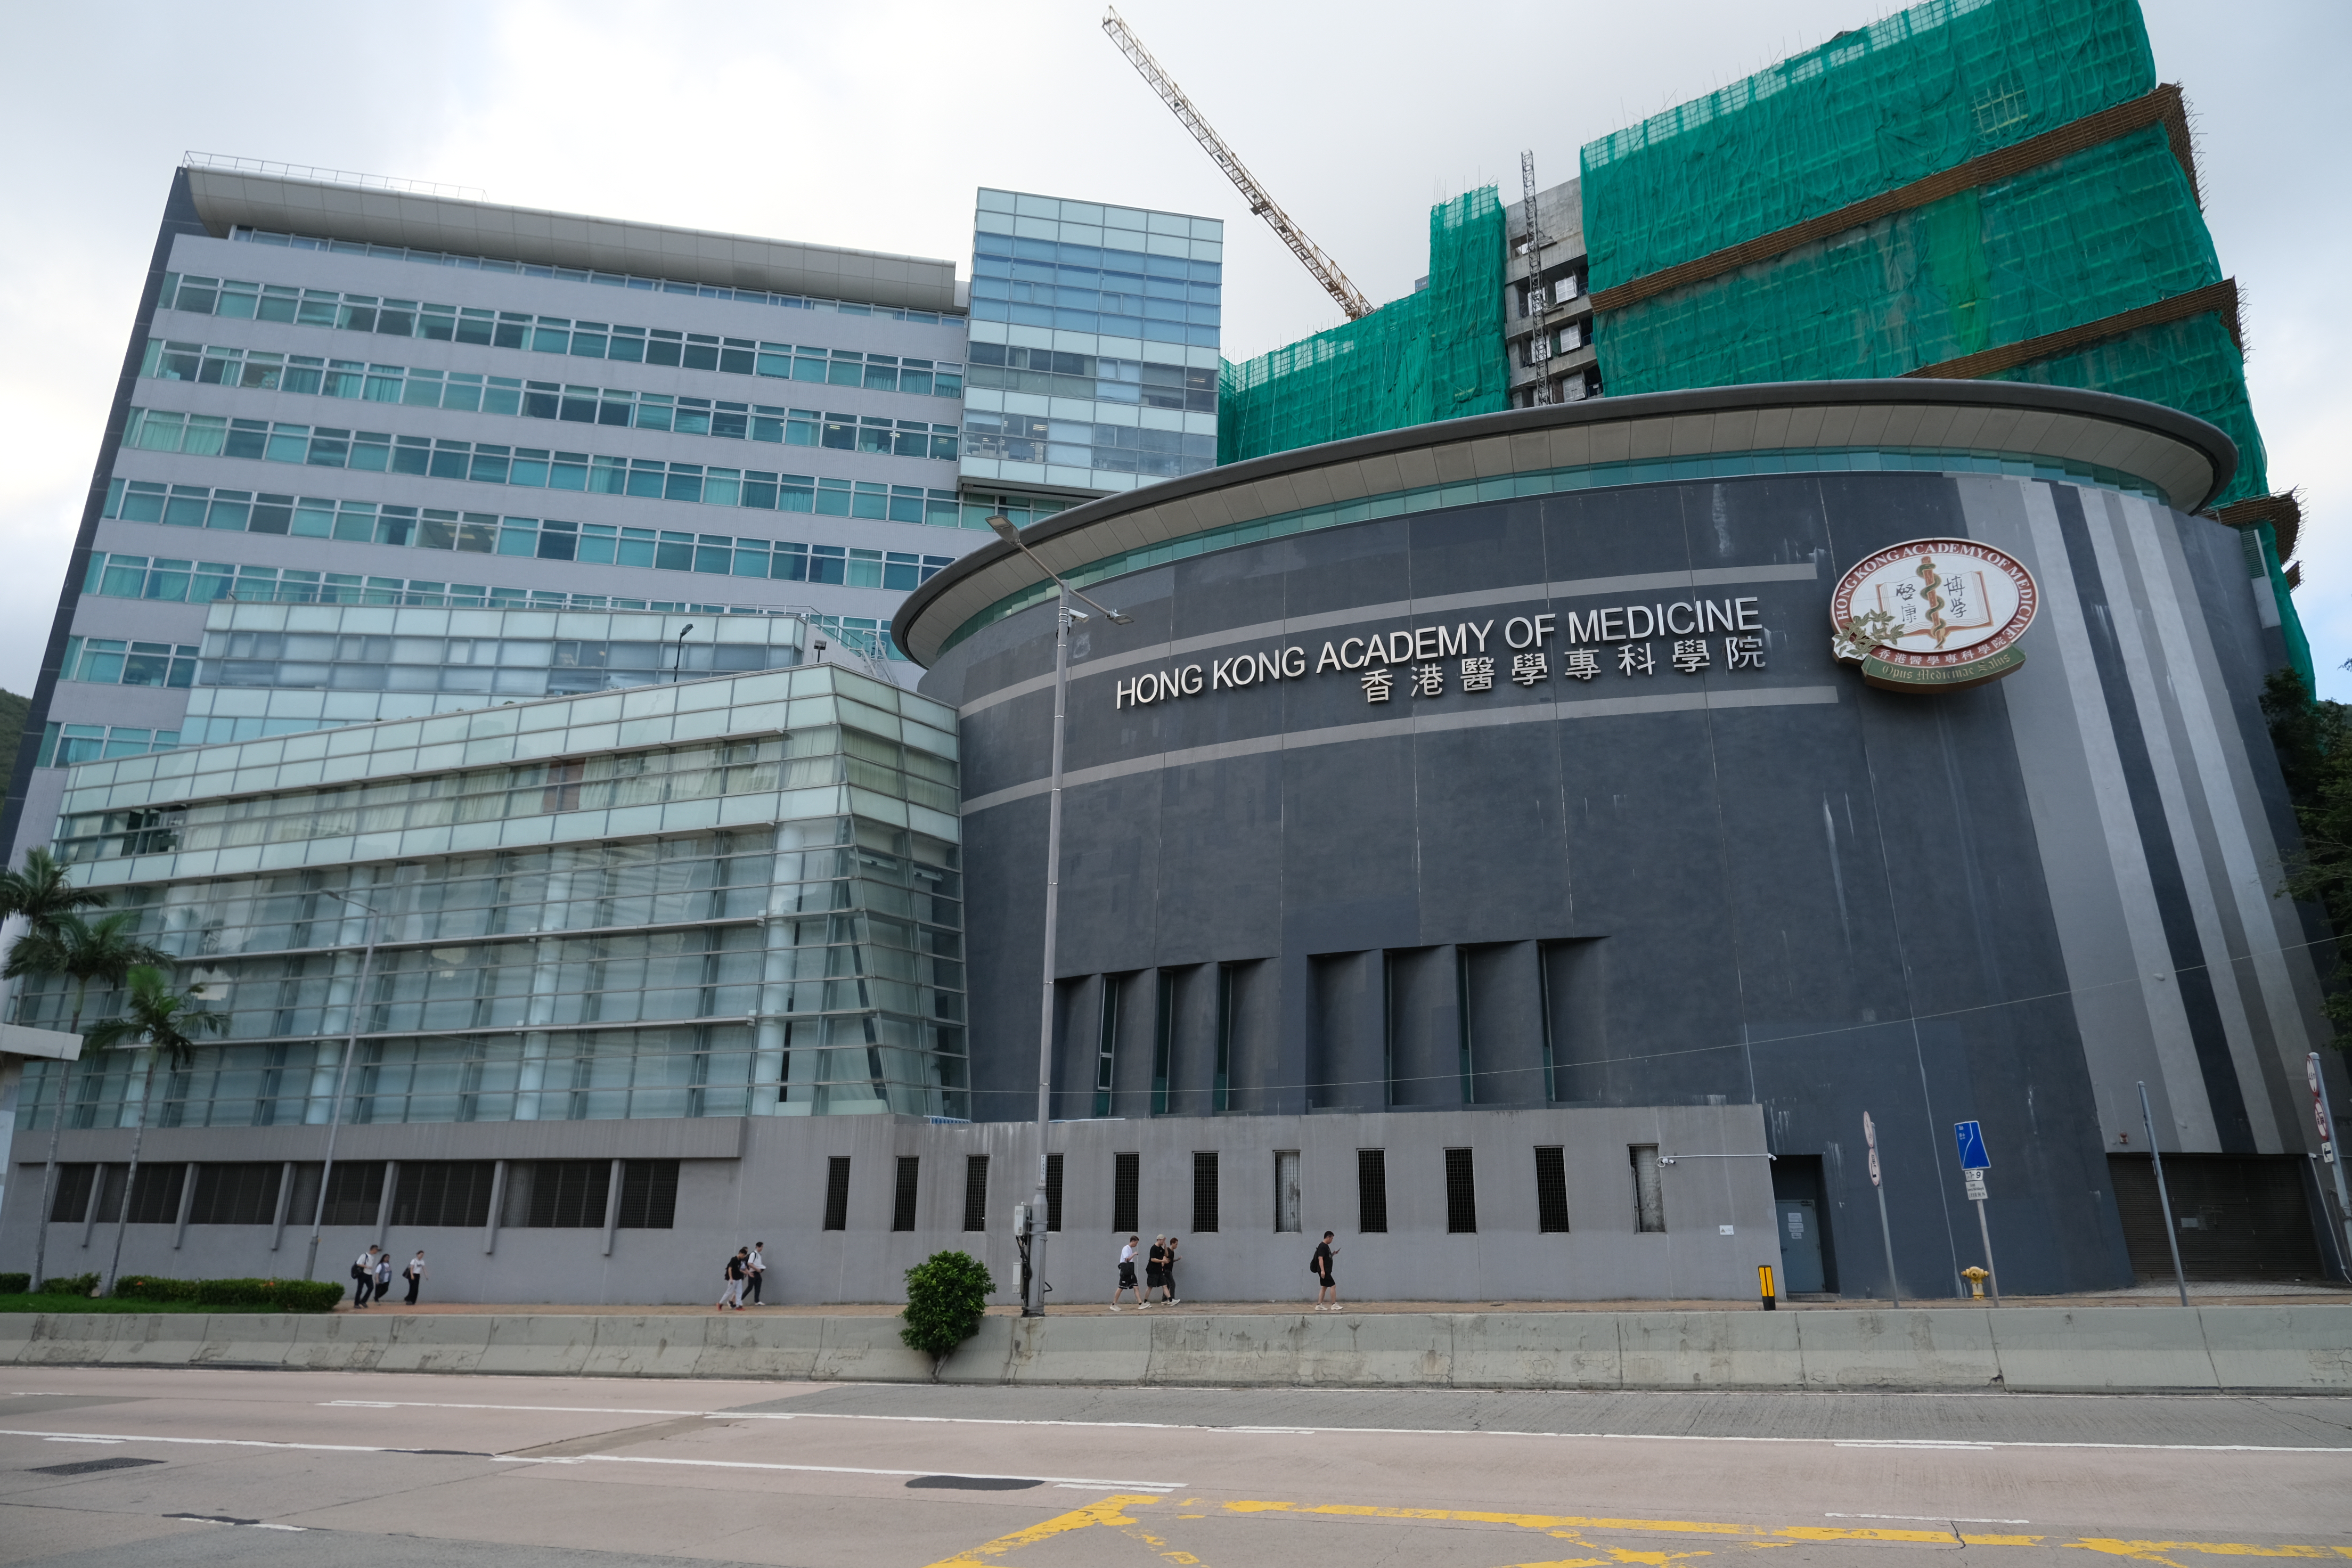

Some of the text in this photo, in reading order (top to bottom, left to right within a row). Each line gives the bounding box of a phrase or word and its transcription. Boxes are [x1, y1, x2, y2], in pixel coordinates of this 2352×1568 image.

[1836, 543, 2033, 640] HONG KONG ACADEMY OF MEDICINE
[1116, 597, 1763, 709] HONG KONG ACADEMY OF MEDICINE
[1361, 635, 1766, 704] 香港醫學專科學院
[1878, 636, 2007, 666] 香港醫學專科學院
[1882, 665, 1913, 679] Opus
[1978, 654, 2011, 673] Salus
